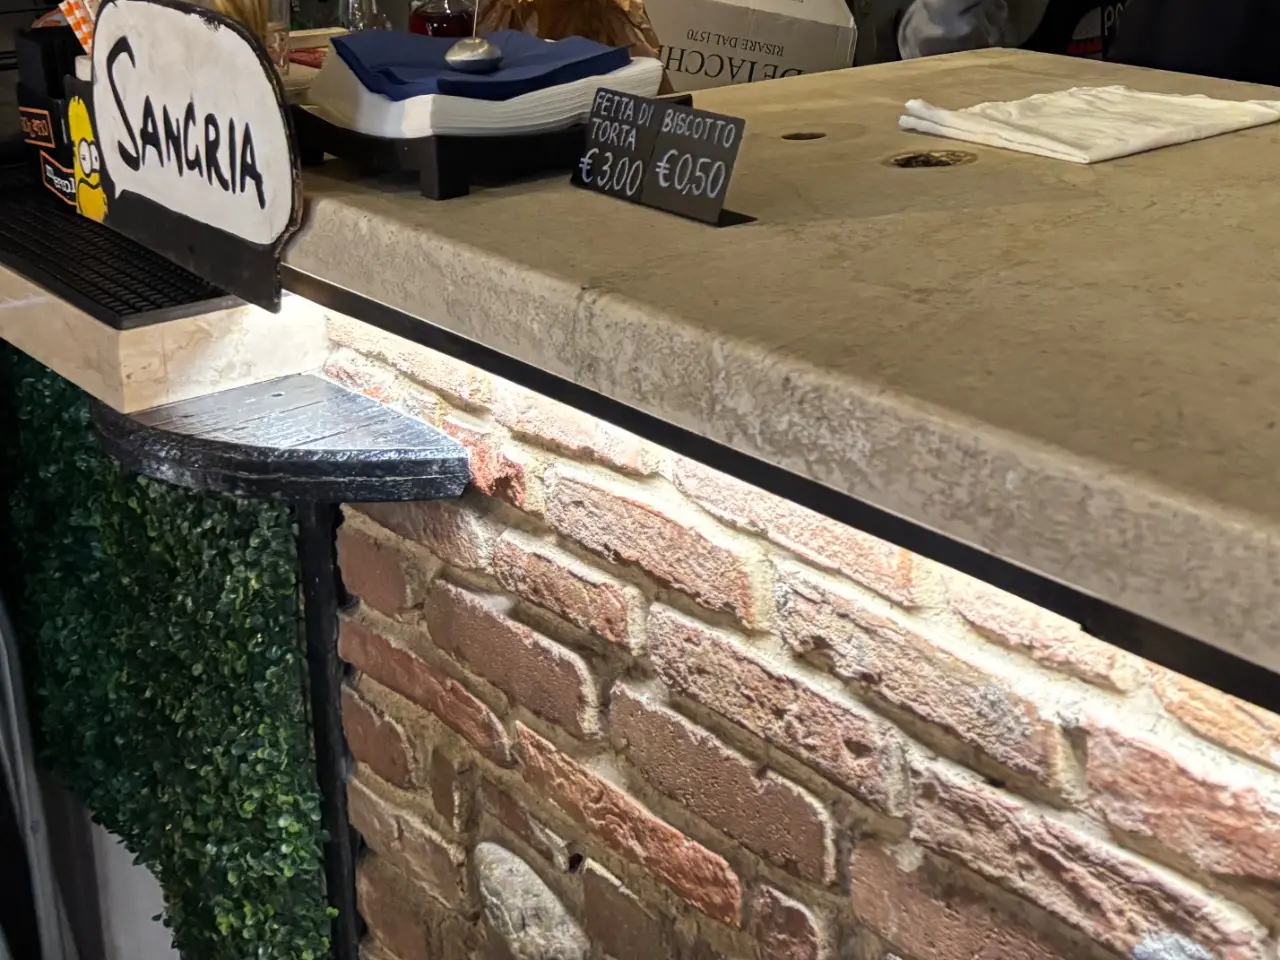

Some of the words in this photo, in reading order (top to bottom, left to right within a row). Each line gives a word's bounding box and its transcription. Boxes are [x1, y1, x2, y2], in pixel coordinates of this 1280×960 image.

[686, 28, 711, 44] 1570
[715, 33, 738, 48] DAL
[742, 37, 784, 57] RISARE
[107, 35, 266, 210] SANGRIA
[594, 91, 635, 123] FETTA
[637, 103, 655, 127] DI
[591, 117, 637, 151] TORTA
[662, 108, 736, 149] BISCOTTO
[655, 148, 726, 199] €0,50
